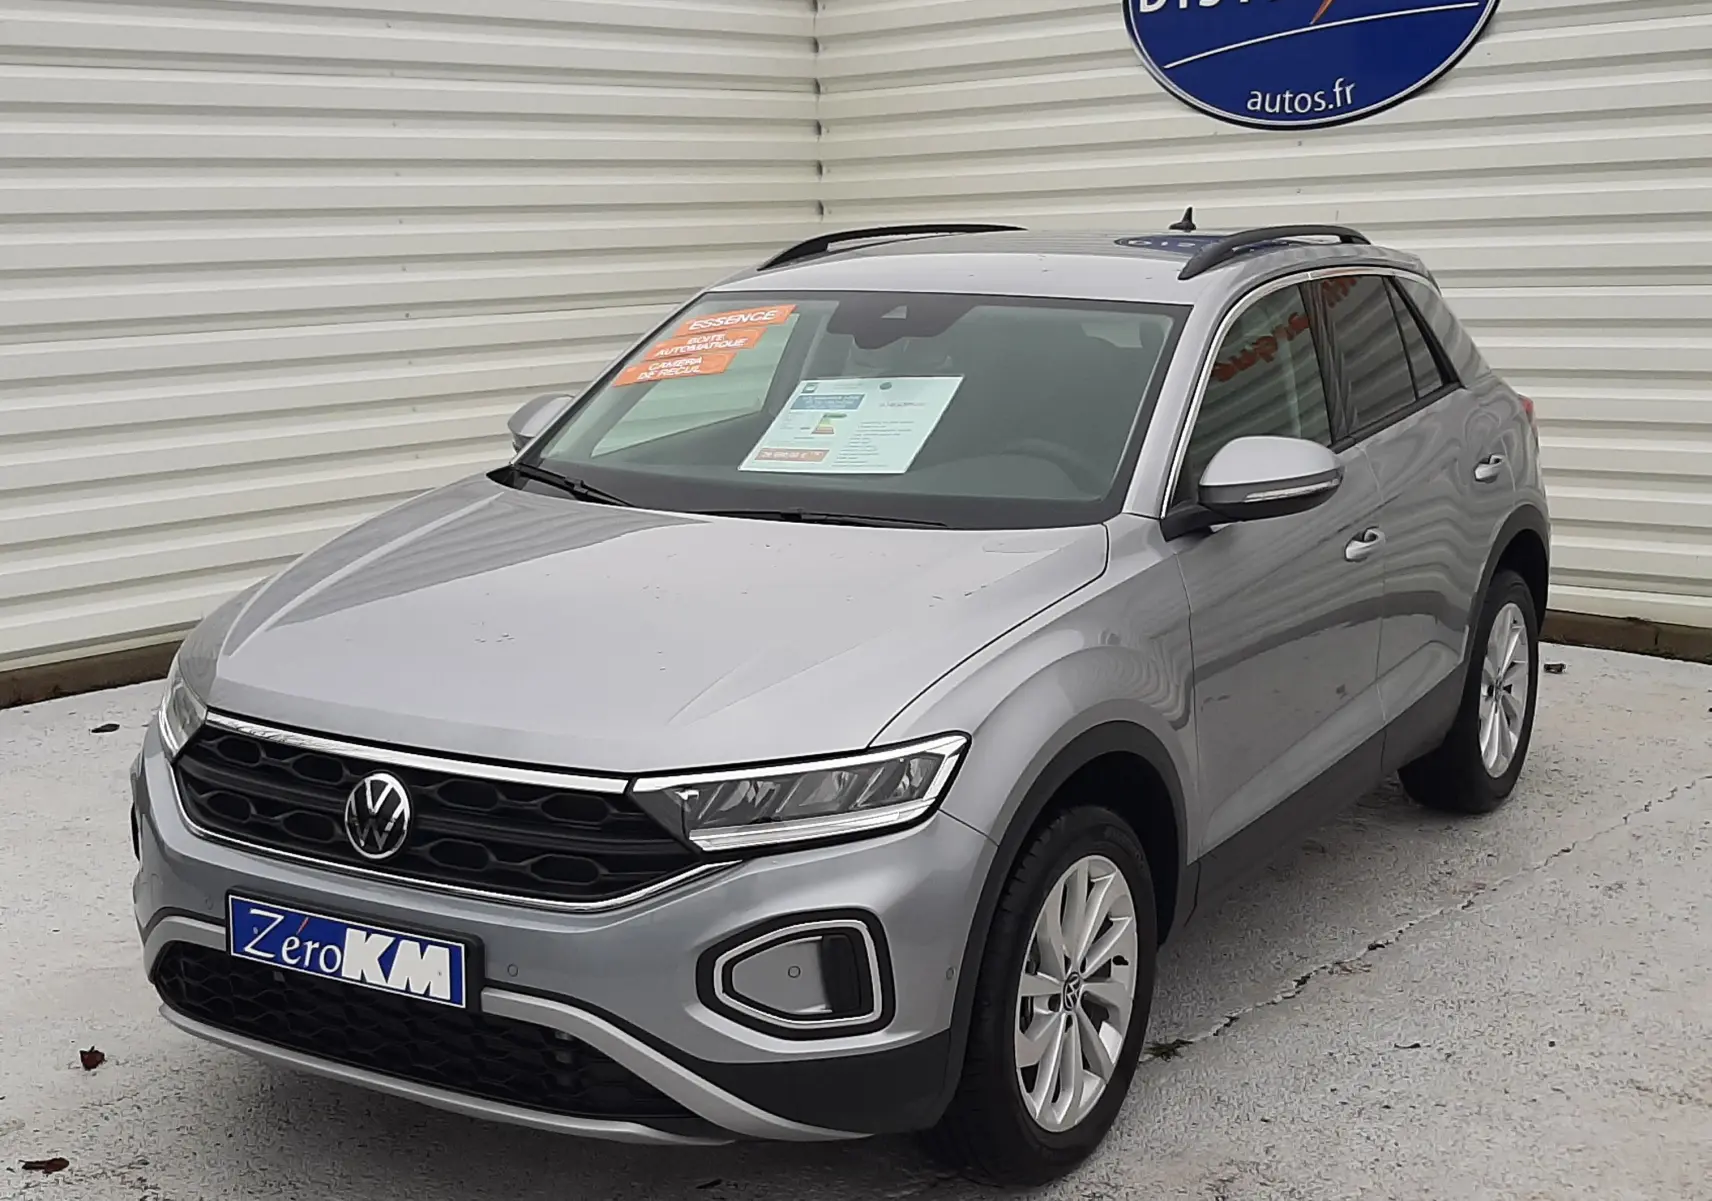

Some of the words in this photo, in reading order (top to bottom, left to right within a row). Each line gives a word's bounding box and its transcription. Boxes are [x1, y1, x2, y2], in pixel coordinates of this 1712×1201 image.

[1246, 79, 1356, 114] autos.fr
[689, 310, 777, 330] ESSENCE
[655, 338, 748, 357] AUTOMATIQUE
[637, 371, 656, 380] DE
[658, 366, 701, 377] RECUL
